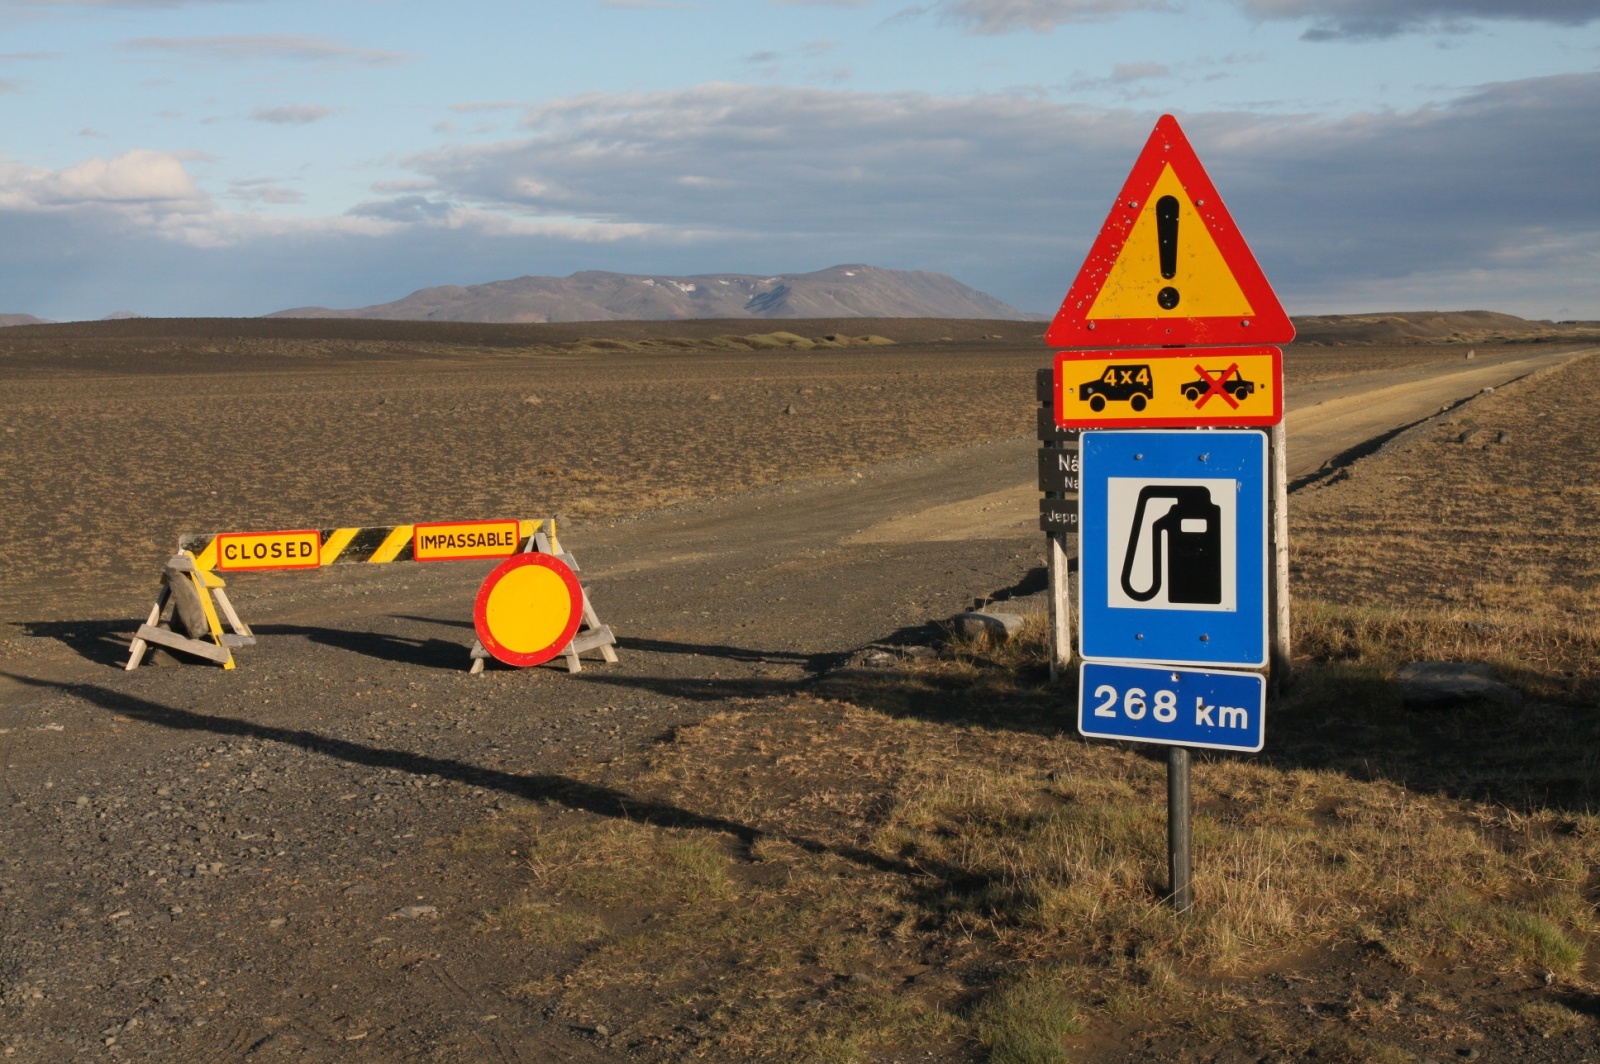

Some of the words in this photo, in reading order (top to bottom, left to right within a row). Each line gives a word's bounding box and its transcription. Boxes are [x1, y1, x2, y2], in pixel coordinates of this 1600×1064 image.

[420, 531, 514, 550] IMPASSABLE
[224, 541, 313, 560] CLOSED
[1094, 684, 1178, 723] 268
[1195, 696, 1248, 730] km
